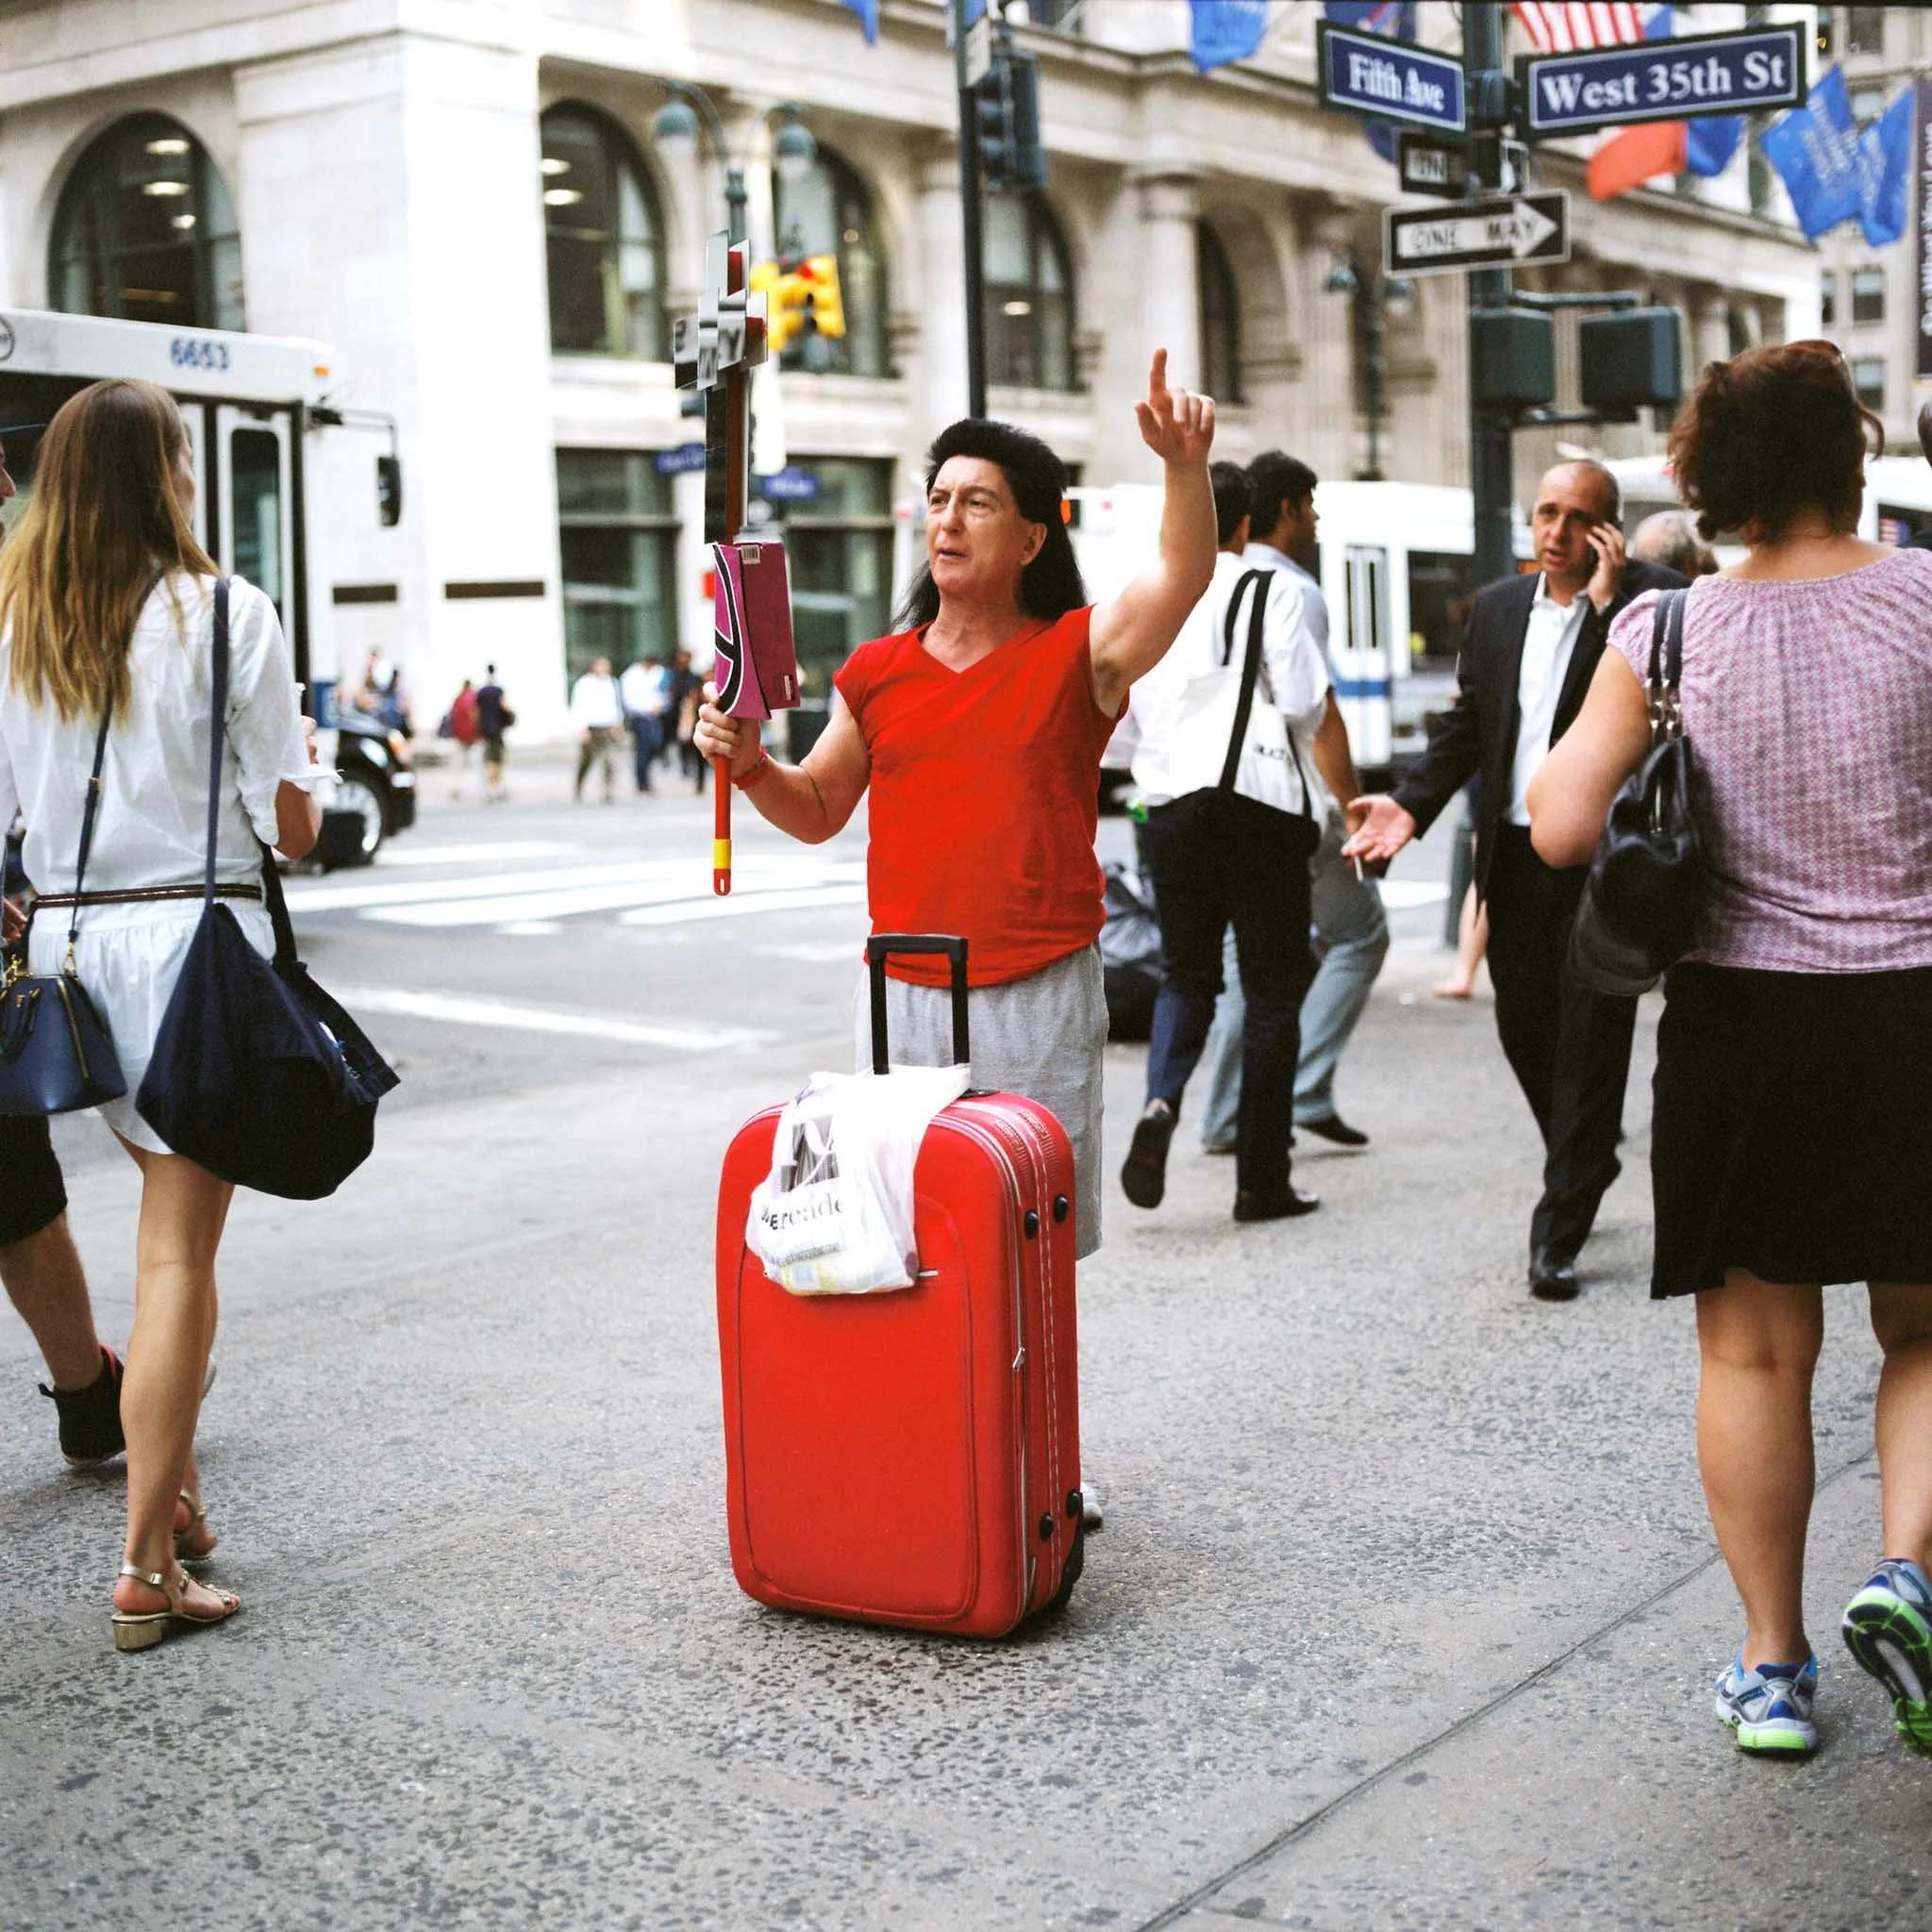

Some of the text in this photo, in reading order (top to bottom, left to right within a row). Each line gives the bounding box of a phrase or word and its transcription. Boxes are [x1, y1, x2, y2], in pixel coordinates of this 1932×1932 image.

[1348, 53, 1444, 112] Fifth Ave
[1541, 50, 1786, 114] West 35th St
[1411, 216, 1538, 251] ONE WAY
[171, 337, 229, 371] 6653
